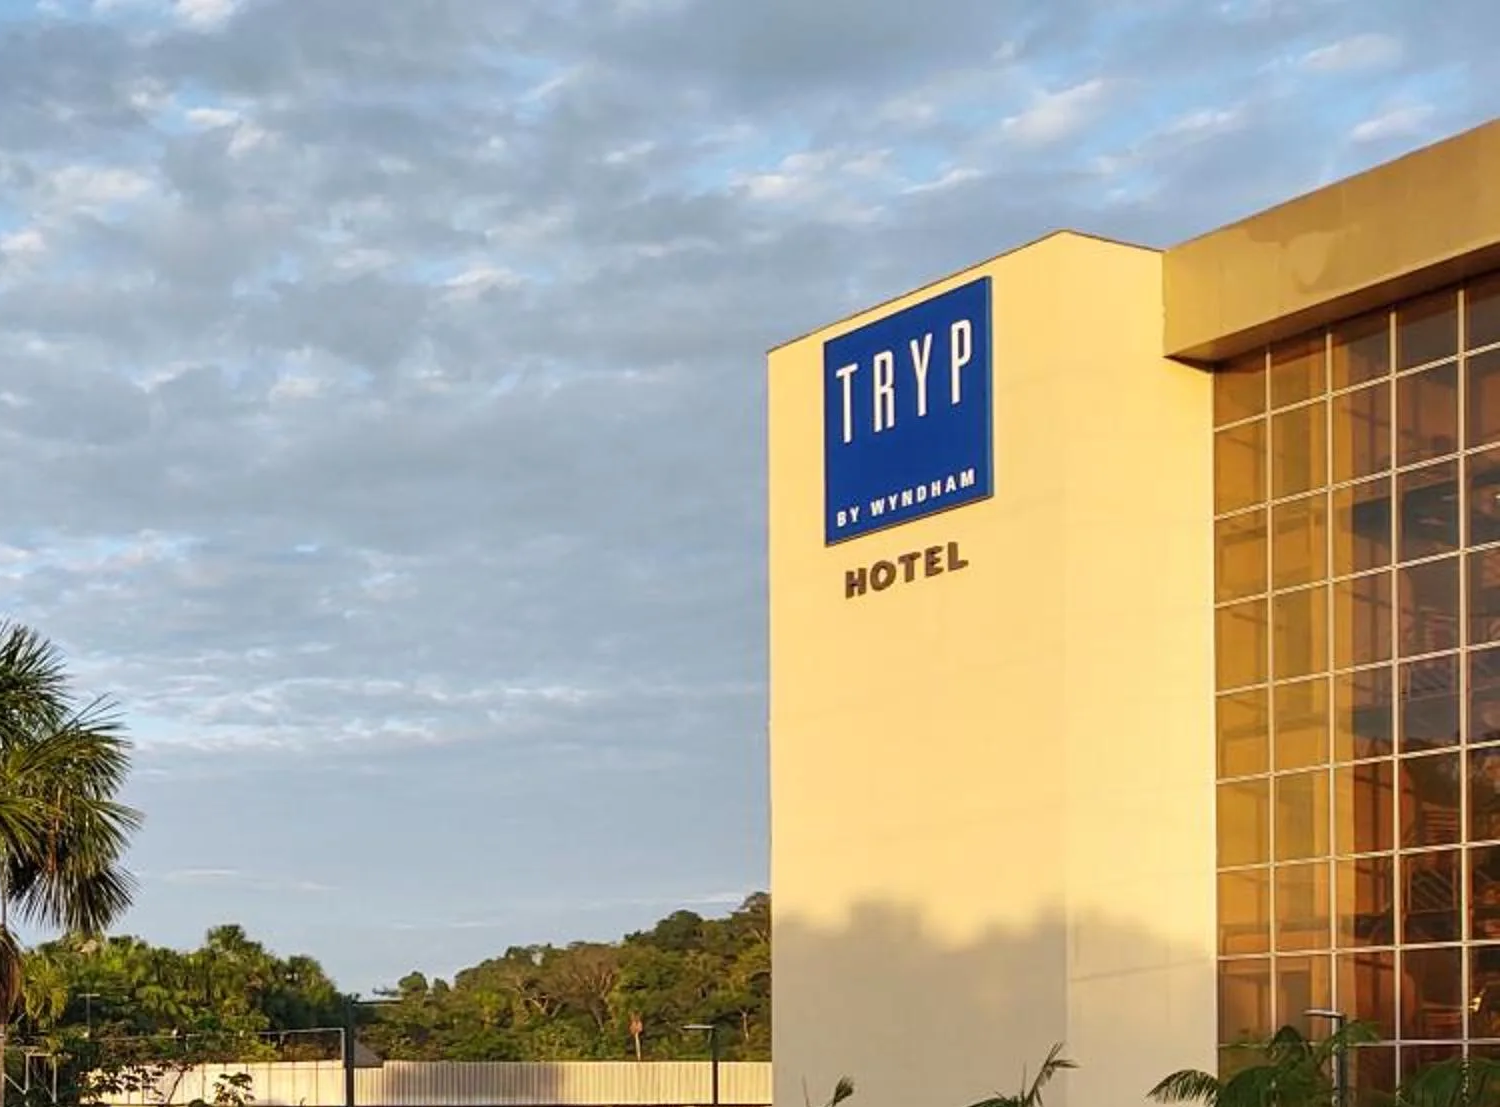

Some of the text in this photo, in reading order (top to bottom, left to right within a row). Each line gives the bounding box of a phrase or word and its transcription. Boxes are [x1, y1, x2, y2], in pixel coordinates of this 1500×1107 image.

[835, 318, 973, 444] TRYP
[836, 468, 975, 528] BY WYNDHAM
[845, 541, 969, 599] HOTEL
